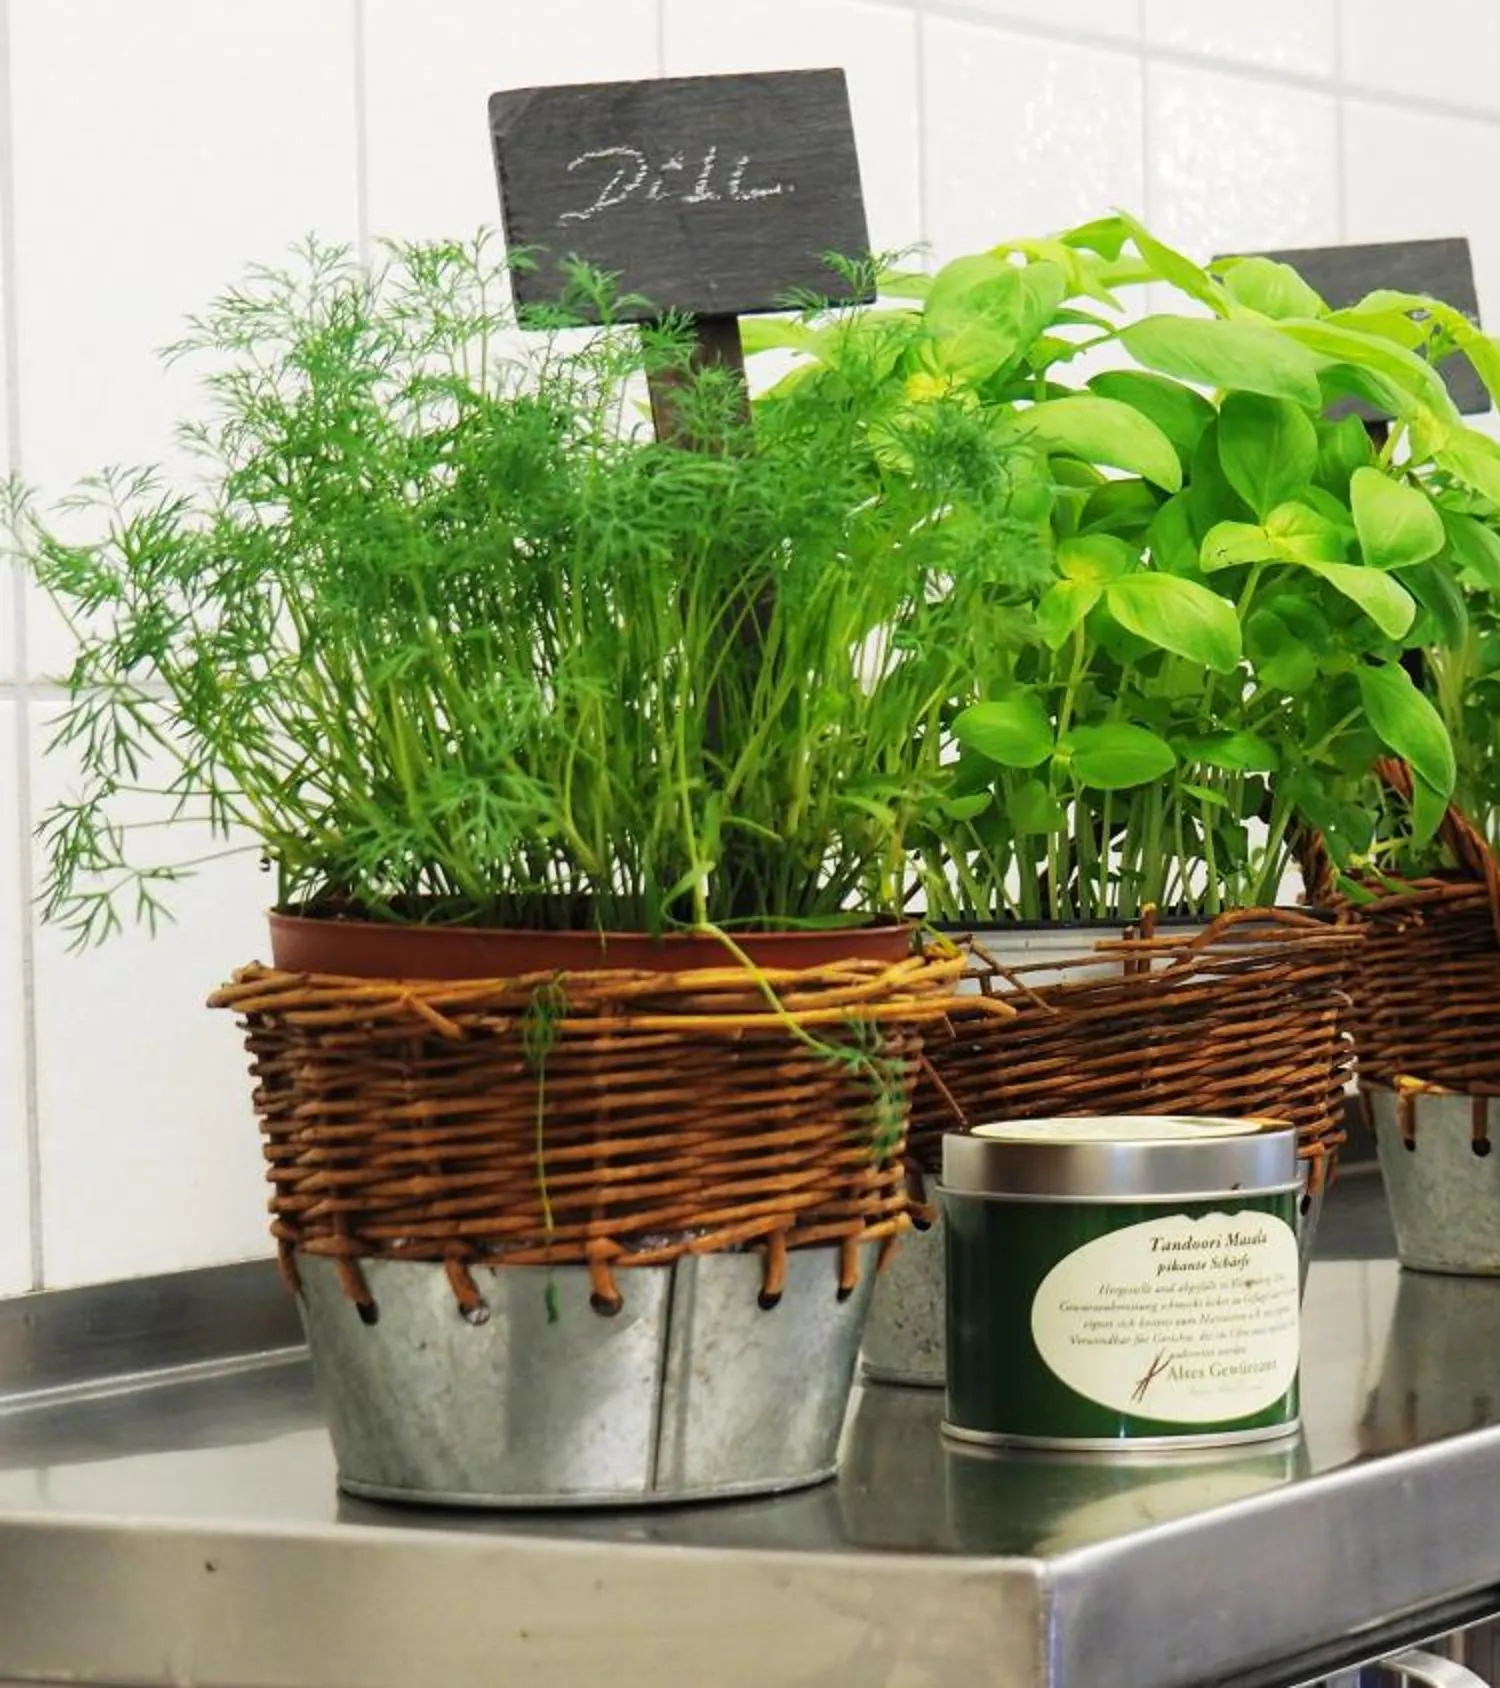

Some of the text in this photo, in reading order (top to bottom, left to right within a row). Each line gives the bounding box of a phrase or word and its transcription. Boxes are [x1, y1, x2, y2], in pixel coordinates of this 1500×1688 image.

[1150, 1227, 1268, 1252] Tandoori Masala
[1156, 1253, 1250, 1277] pikante Schärfe
[1167, 1364, 1205, 1382] Altes
